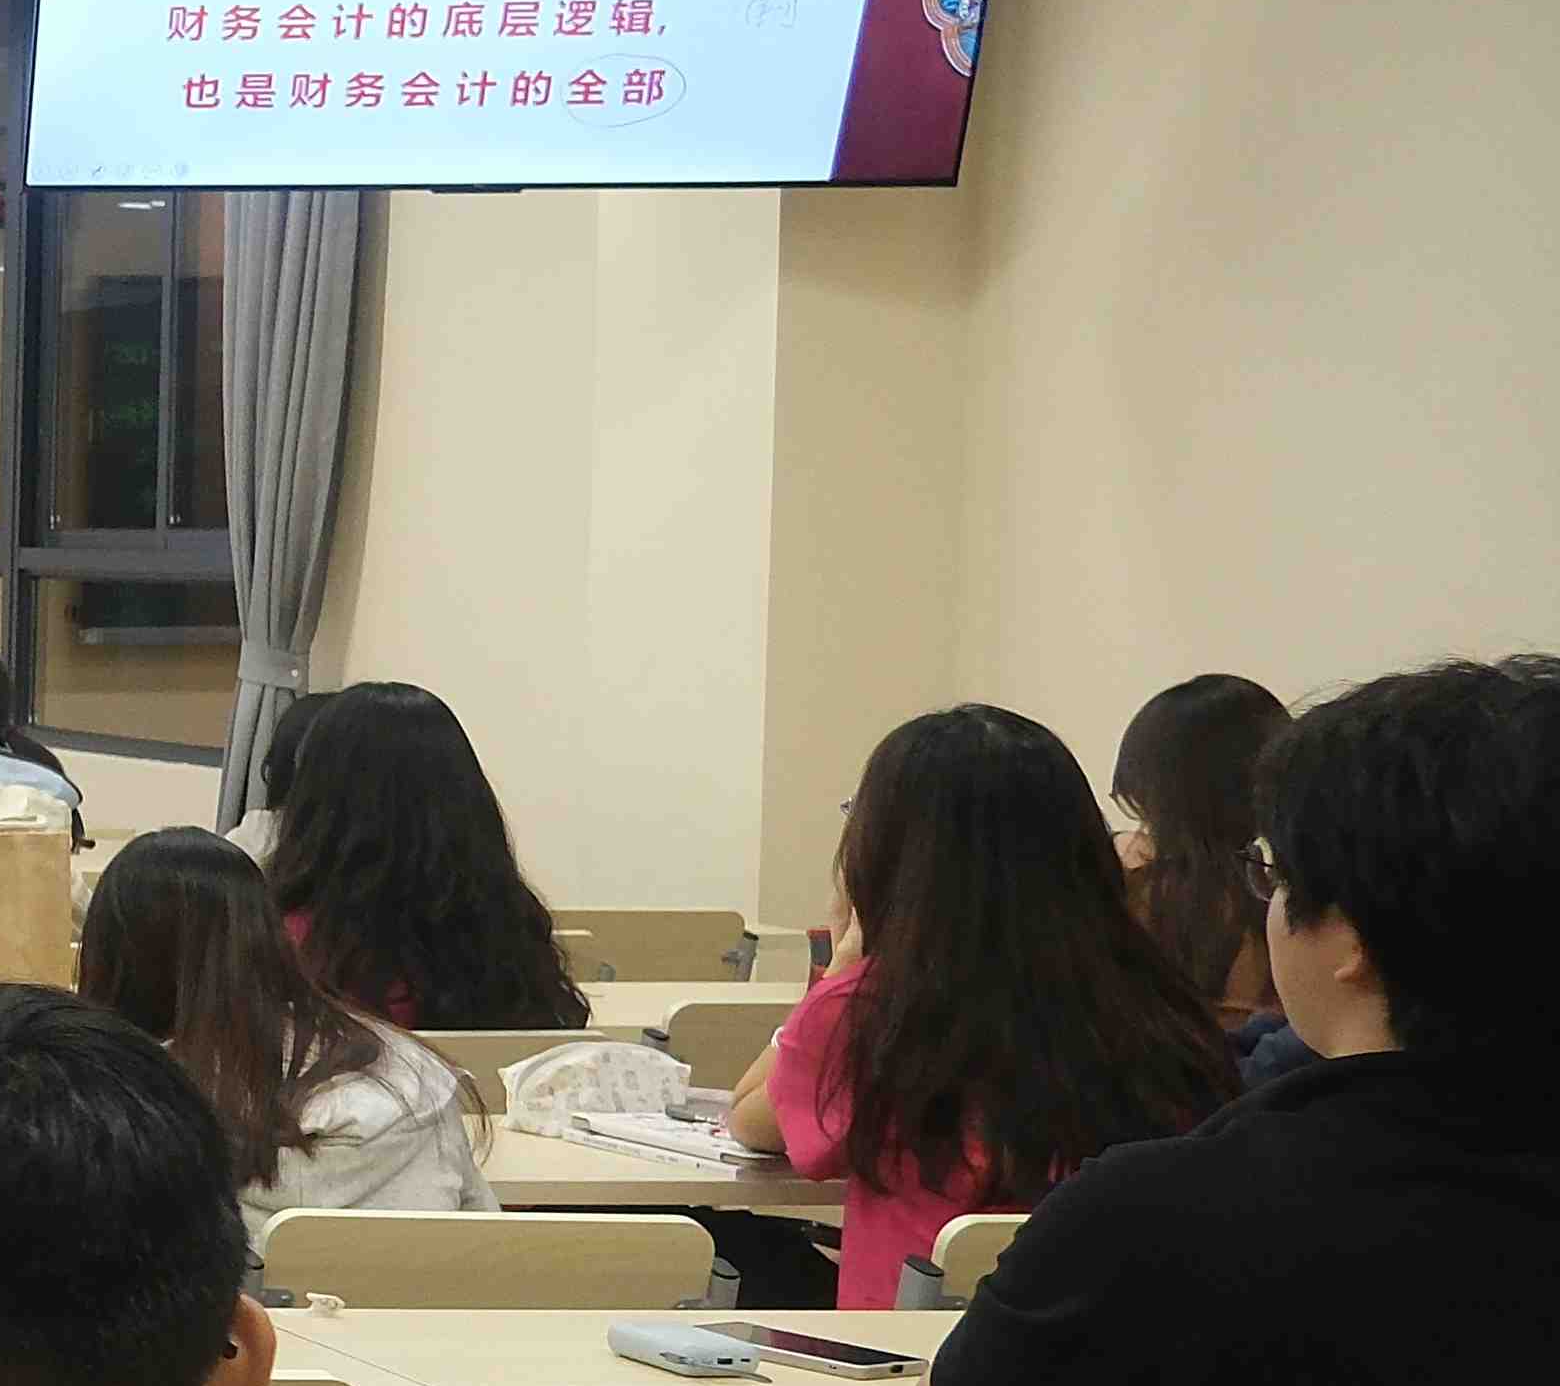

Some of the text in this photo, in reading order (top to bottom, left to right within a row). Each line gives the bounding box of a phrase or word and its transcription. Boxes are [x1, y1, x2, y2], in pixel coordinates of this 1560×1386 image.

[182, 69, 666, 110] 也是财务会计的全部
